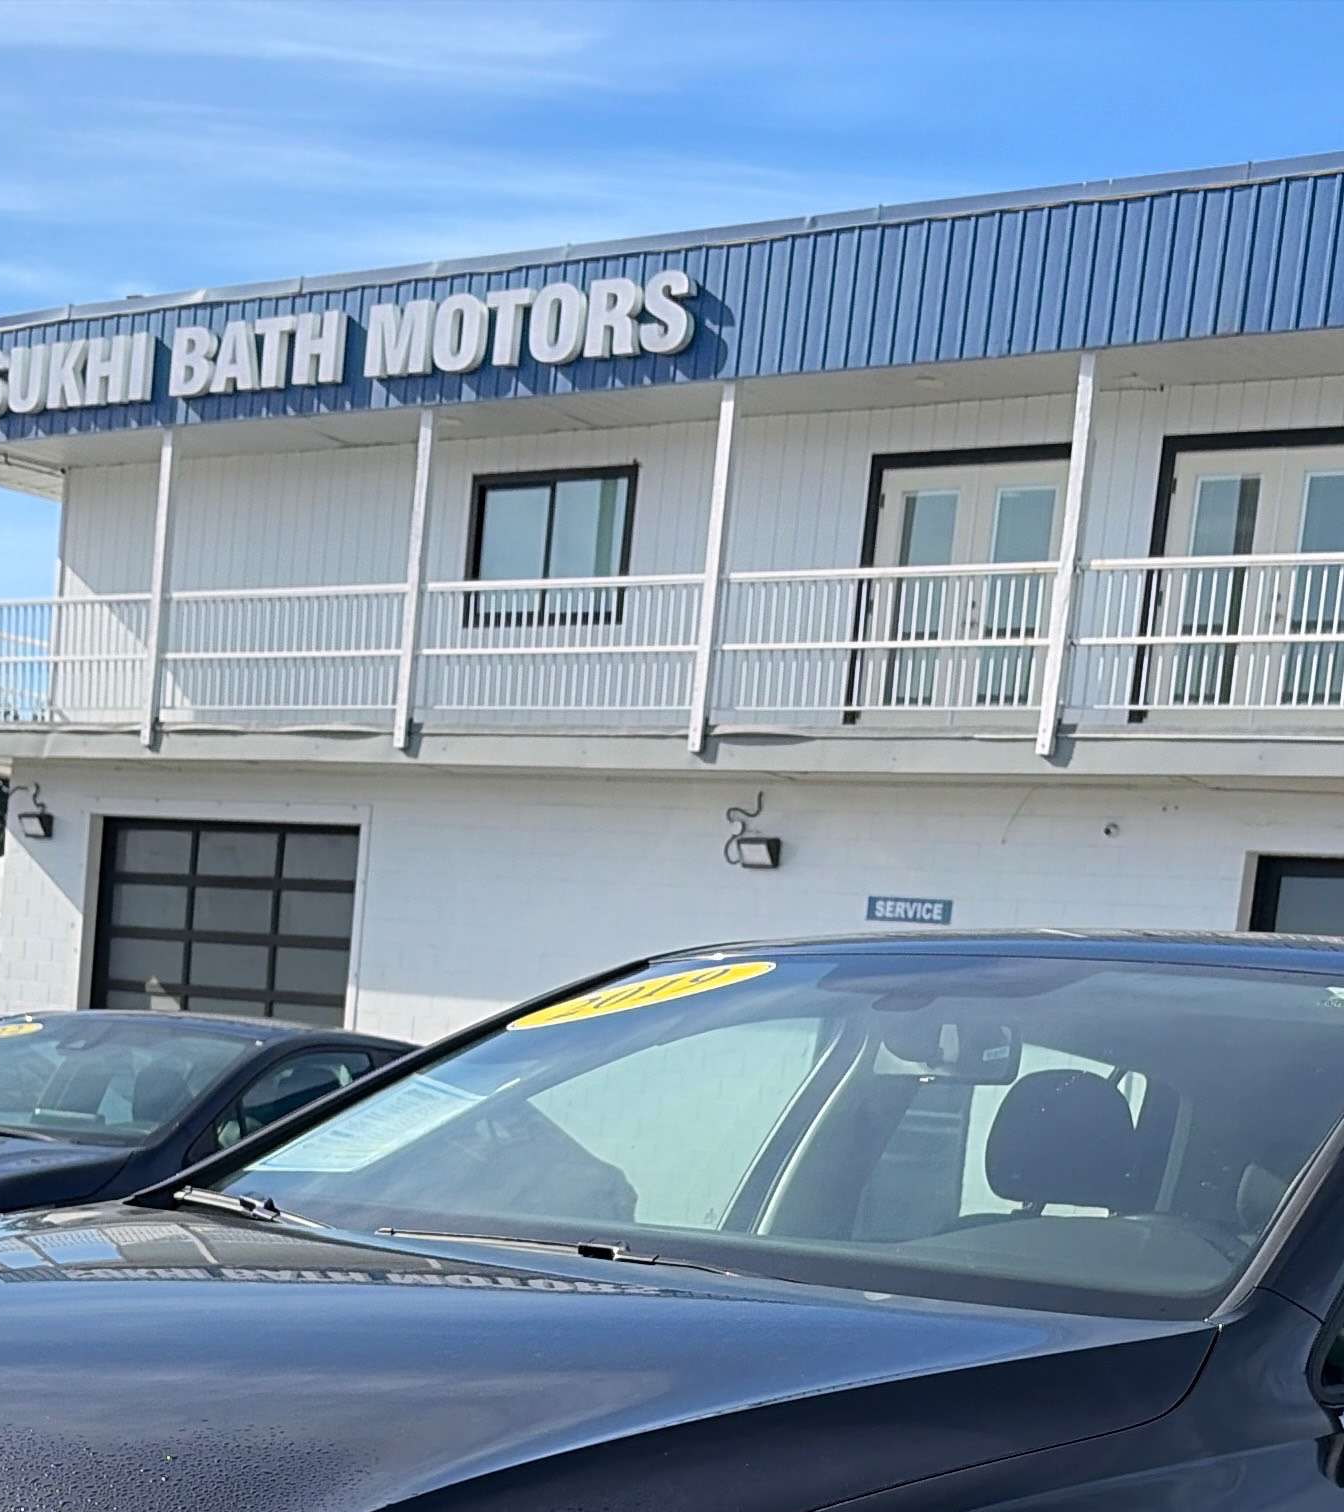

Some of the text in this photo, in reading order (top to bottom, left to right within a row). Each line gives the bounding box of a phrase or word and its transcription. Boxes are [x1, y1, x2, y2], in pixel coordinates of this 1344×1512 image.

[168, 309, 349, 398] BATH
[364, 269, 695, 379] MOTORS
[874, 900, 945, 921] SERVICE
[545, 968, 732, 1021] 2019
